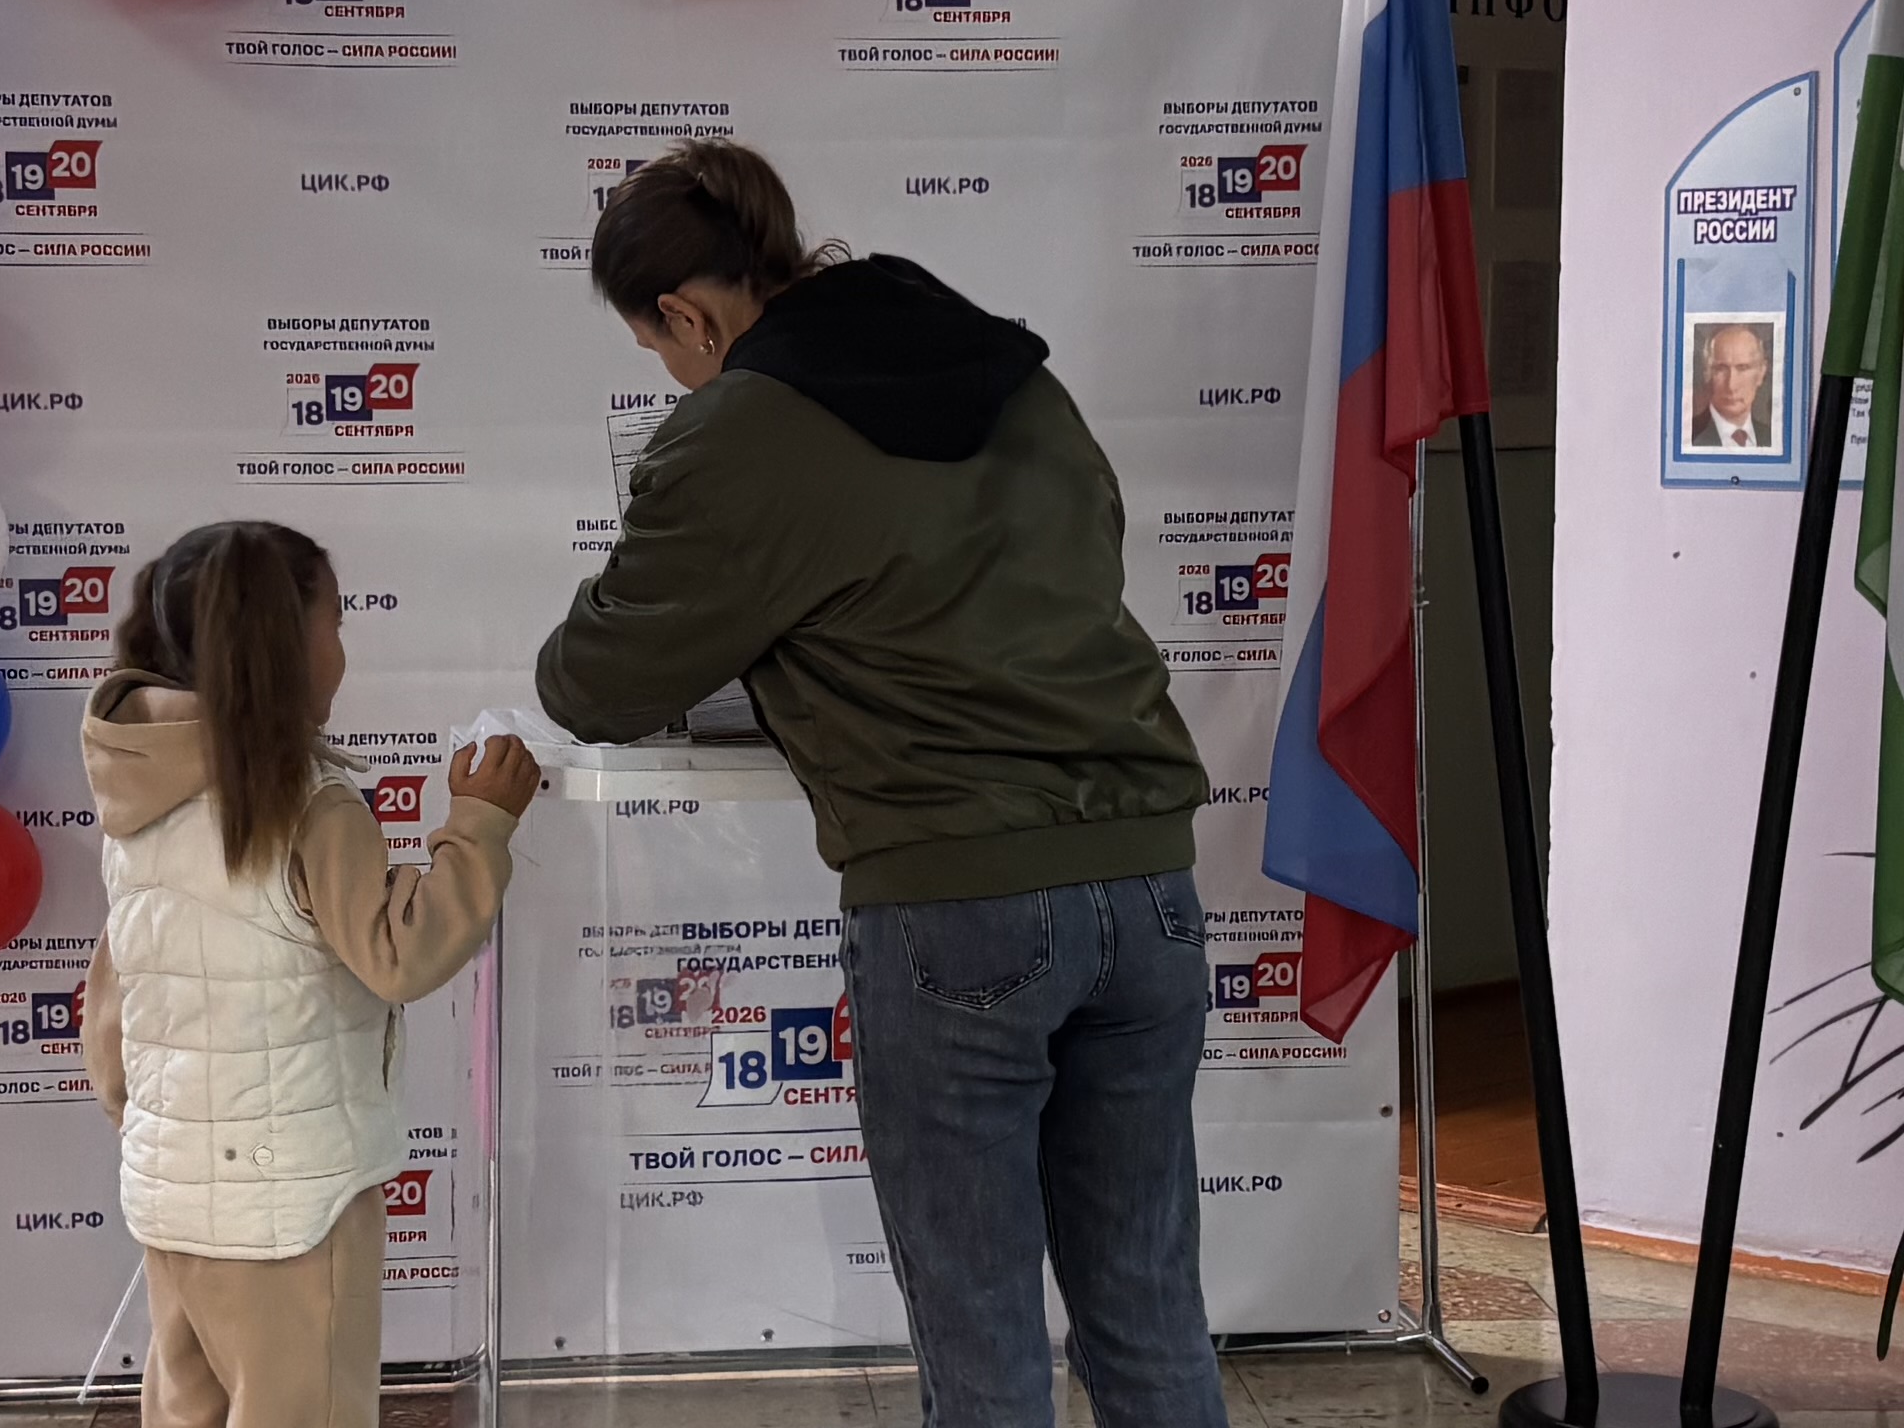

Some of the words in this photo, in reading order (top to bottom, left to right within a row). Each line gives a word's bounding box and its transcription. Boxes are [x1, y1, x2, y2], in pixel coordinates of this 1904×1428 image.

[324, 5, 405, 18] СЕНТЯБРЯ
[933, 11, 1011, 23] СЕНТЯБРЯ
[225, 41, 268, 56] ТВОЙ
[272, 44, 324, 56] ГОЛОС
[342, 45, 384, 58] СИЛА
[388, 45, 457, 59] РОССИИ!
[838, 47, 879, 62] ТВОЙ
[883, 49, 933, 62] ГОЛОС
[949, 49, 991, 62] СИЛА
[995, 49, 1059, 62] РОССИИ!
[18, 94, 112, 107] ДЕПУТАТОВ
[1163, 101, 1228, 115] ВЫБОРЫ
[1231, 100, 1318, 115] ДЕПУТАТОВ
[570, 102, 637, 115] ВЫБОРЫ
[640, 103, 729, 117] ДЕПУТАТОВ
[76, 117, 117, 128] ДУМЫ
[1159, 121, 1281, 135] ГОСУДАРСТВЕННОЙ
[1283, 122, 1322, 135] ДУМЫ
[566, 124, 692, 137] ГОСУДАРСТВЕННОЙ
[694, 125, 733, 137] ДУМЫ
[588, 159, 621, 170] 2026
[1180, 156, 1213, 167] 2026
[11, 164, 44, 190] 19
[52, 151, 91, 178] 20
[301, 173, 389, 193] ЦИК.РФ
[906, 176, 990, 197] ЦИК.РФ
[1185, 184, 1216, 208] 18
[1222, 168, 1253, 194] 19
[1259, 155, 1296, 181] 20
[1677, 184, 1797, 217] ПРЕЗИДЕНТ
[15, 205, 98, 217] СЕНТЯБРЯ
[1225, 206, 1301, 219] СЕНТЯБРЯ
[1694, 216, 1777, 245] РОССИИ
[34, 244, 77, 257] СИЛА
[80, 245, 151, 258] РОССИИ!
[540, 246, 581, 261] ТВОЙ
[1133, 243, 1173, 259] ТВОЙ
[1177, 245, 1225, 259] ГОЛОС
[1241, 244, 1280, 257] СИЛА
[267, 318, 336, 331] ВЫБОРЫ
[339, 319, 430, 332] ДЕПУТАТОВ
[264, 339, 393, 352] ГОСУДАРСТВЕННОЙ
[395, 340, 435, 352] ДУМЫ
[286, 373, 321, 384] 2026
[292, 401, 324, 426] 18
[330, 387, 363, 412] 19
[370, 374, 409, 399] 20
[1199, 387, 1282, 407] ЦИК.РФ
[334, 425, 414, 437] СЕНТЯБРЯ
[237, 460, 279, 475] ТВОЙ
[283, 462, 334, 475] ГОЛОС
[352, 462, 394, 475] СИЛА
[398, 462, 465, 475] РОССИИ!
[1164, 512, 1227, 525] ВЫБОРЫ
[32, 522, 125, 536] ДЕПУТАТОВ
[1159, 530, 1278, 544] ГОСУДАРСТВЕННОЙ
[89, 545, 130, 556] ДУМЫ
[1178, 564, 1210, 575] 2026
[24, 591, 57, 616] 19
[65, 578, 104, 603] 20
[1183, 591, 1213, 615] 18
[1220, 576, 1250, 601] 19
[1257, 564, 1290, 588] 20
[28, 630, 110, 642] СЕНТЯБРЯ
[1173, 651, 1221, 663] ГОЛОС
[1237, 649, 1277, 661] СИЛА
[46, 668, 89, 680] СИЛА
[347, 733, 437, 746] ДЕПУТАТОВ
[402, 754, 442, 765] ДУМЫ
[378, 787, 417, 812] 20
[616, 799, 700, 818] ЦИК.РФ
[682, 920, 786, 940] ВЫБОРЫ
[1220, 975, 1250, 999] 19
[1257, 963, 1294, 986] 20
[37, 1004, 70, 1029] 19
[712, 1006, 766, 1024] 2026
[1223, 1011, 1298, 1023] СЕНТЯБРЯ
[718, 1050, 767, 1089] 18
[779, 1025, 827, 1065] 19
[1239, 1047, 1280, 1059] СИЛА
[1282, 1047, 1347, 1059] РОССИИ!
[409, 1148, 447, 1160] ДУМЫ
[630, 1146, 695, 1171] ТВОЙ
[702, 1148, 782, 1169] ГОЛОС
[1201, 1175, 1282, 1195] ЦИК.РФ
[384, 1181, 422, 1206] 20
[620, 1190, 704, 1211] ЦИК.РФ
[16, 1211, 104, 1232] ЦИК.РФ
